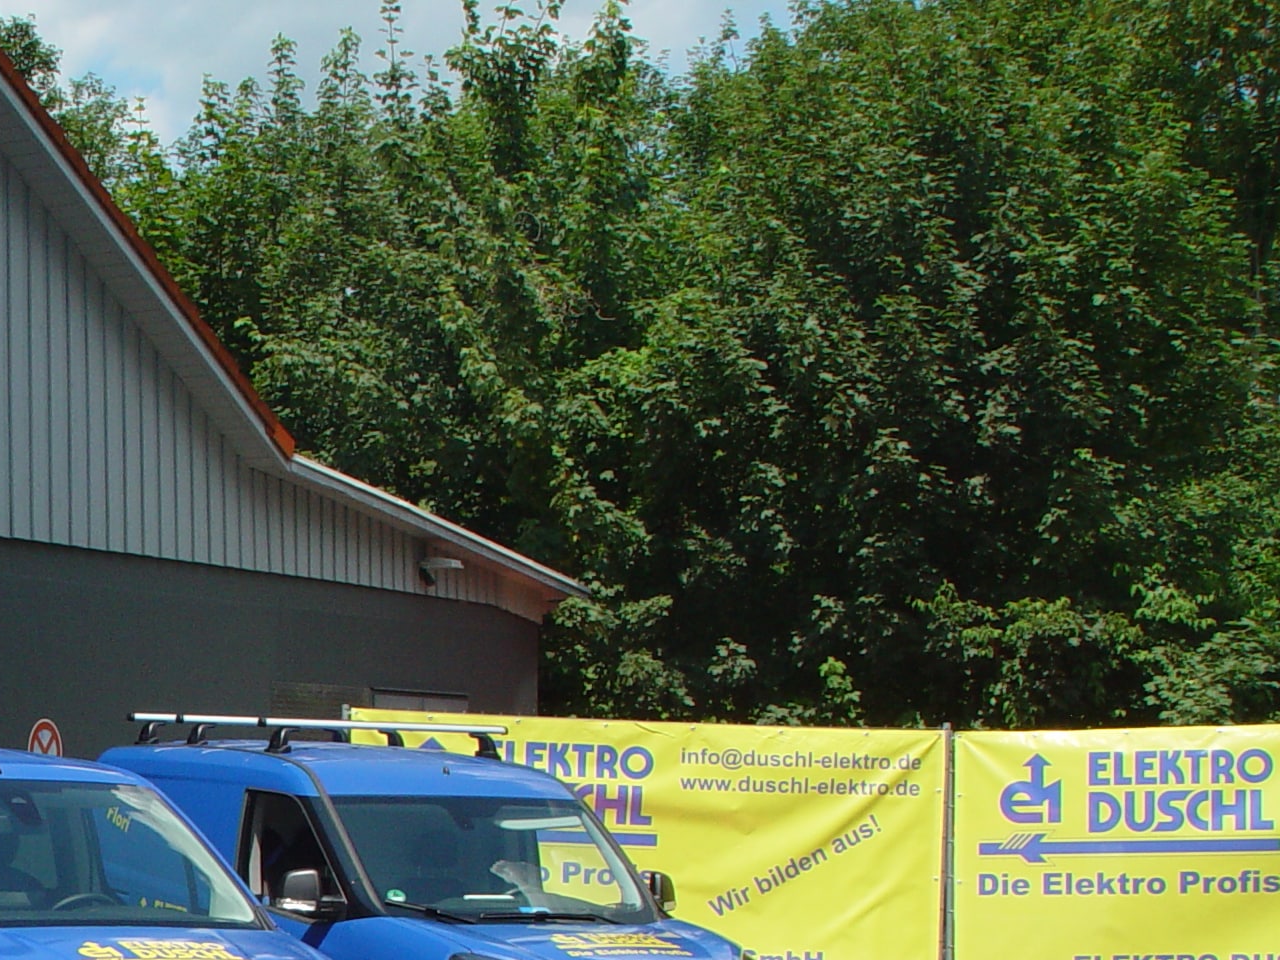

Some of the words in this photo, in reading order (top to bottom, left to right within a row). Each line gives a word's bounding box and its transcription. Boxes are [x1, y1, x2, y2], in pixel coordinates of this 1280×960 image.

[493, 741, 654, 779] LEKTRO
[680, 747, 921, 771] info@duschl-elektro.de
[1088, 748, 1274, 786] ELEKTRO
[680, 776, 920, 796] www.duschl-elektro.de
[1088, 790, 1274, 832] DUSCHL
[708, 887, 750, 917] Wir
[754, 847, 828, 895] bilden
[831, 814, 882, 855] aus!
[978, 873, 1031, 895] Die
[1043, 871, 1166, 895] Elektro
[1179, 870, 1280, 894] Profis
